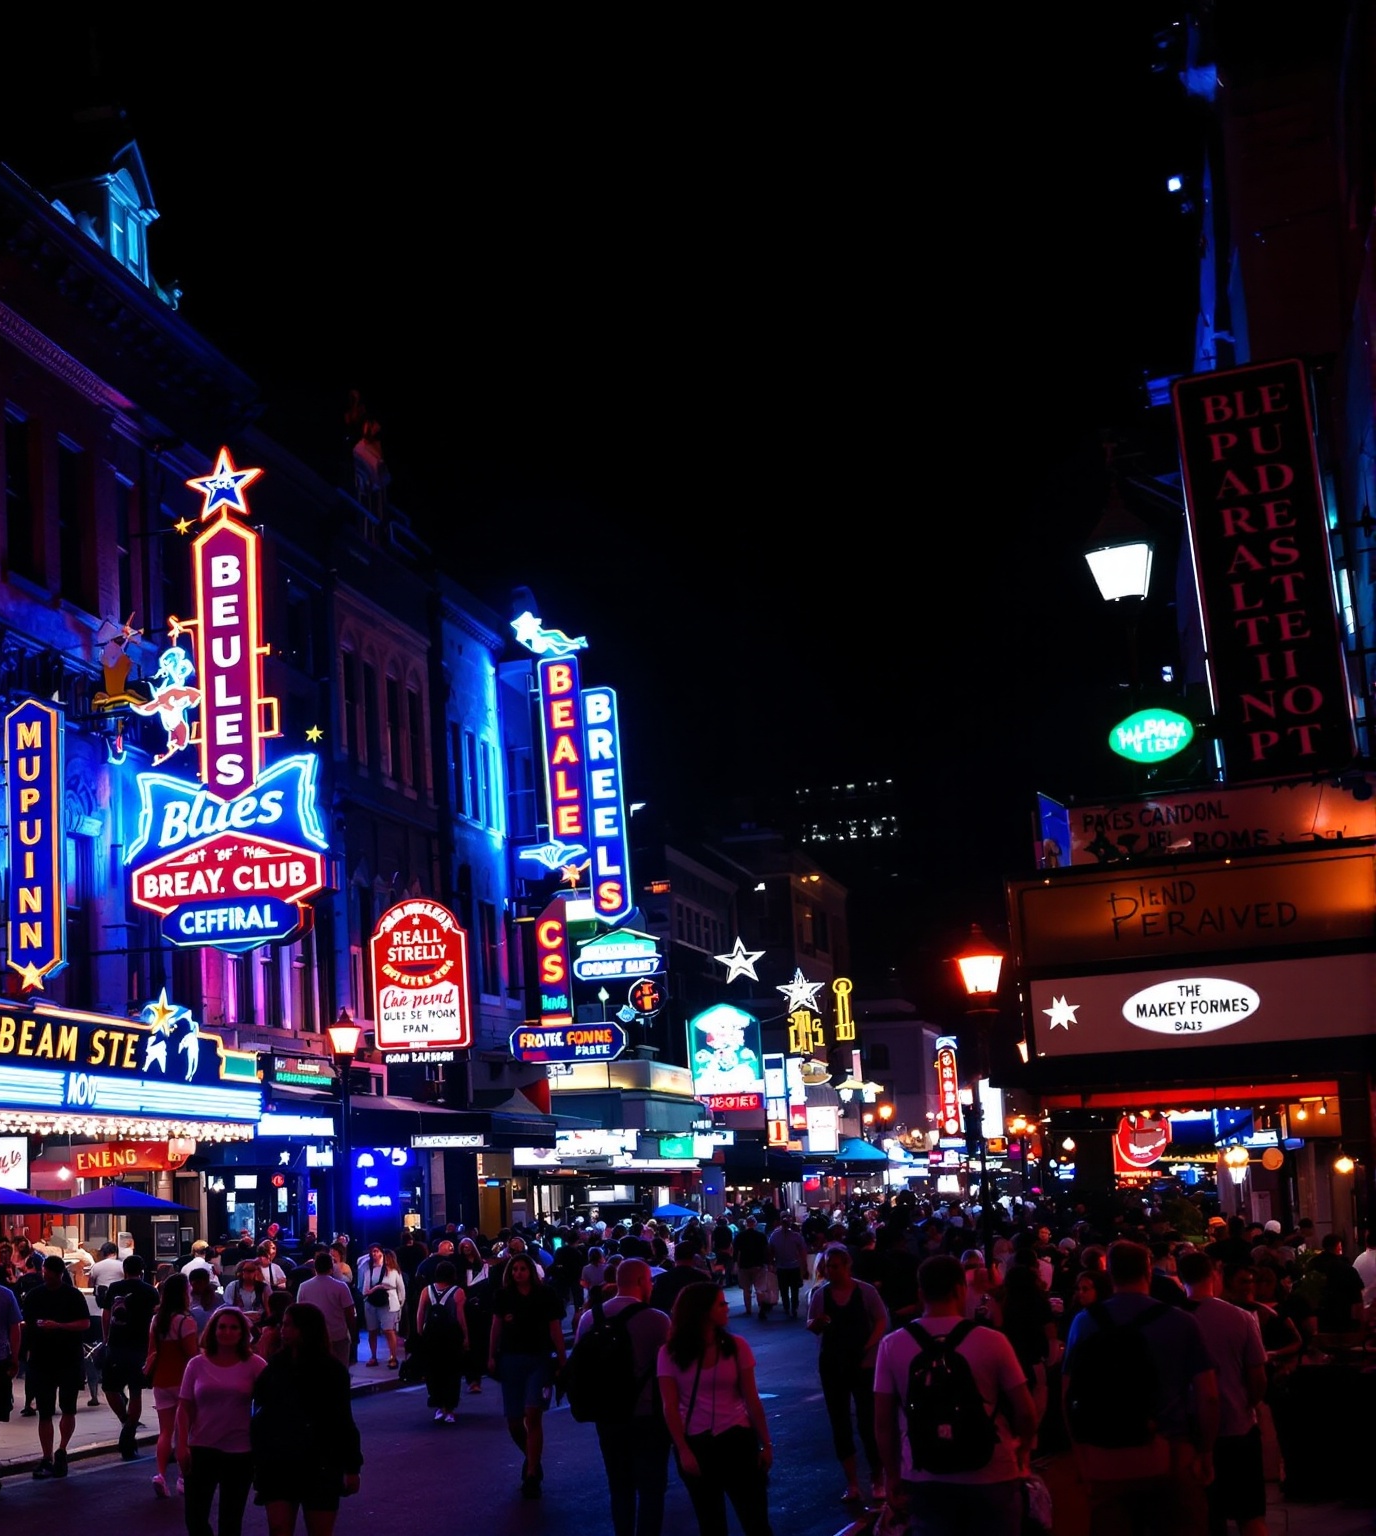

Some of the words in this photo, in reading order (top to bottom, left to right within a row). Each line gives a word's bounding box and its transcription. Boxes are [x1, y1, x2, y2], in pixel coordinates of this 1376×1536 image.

[211, 555, 244, 786] BEULES
[548, 664, 582, 835] BEALE
[158, 790, 284, 848] Blues
[585, 692, 623, 911] BREELS
[232, 861, 307, 891] CLUB
[393, 929, 441, 945] REALL
[1136, 1001, 1187, 1018] MAKEY
[1190, 998, 1249, 1014] FORMES
[1178, 984, 1202, 997] THE
[88, 1029, 140, 1069] STE
